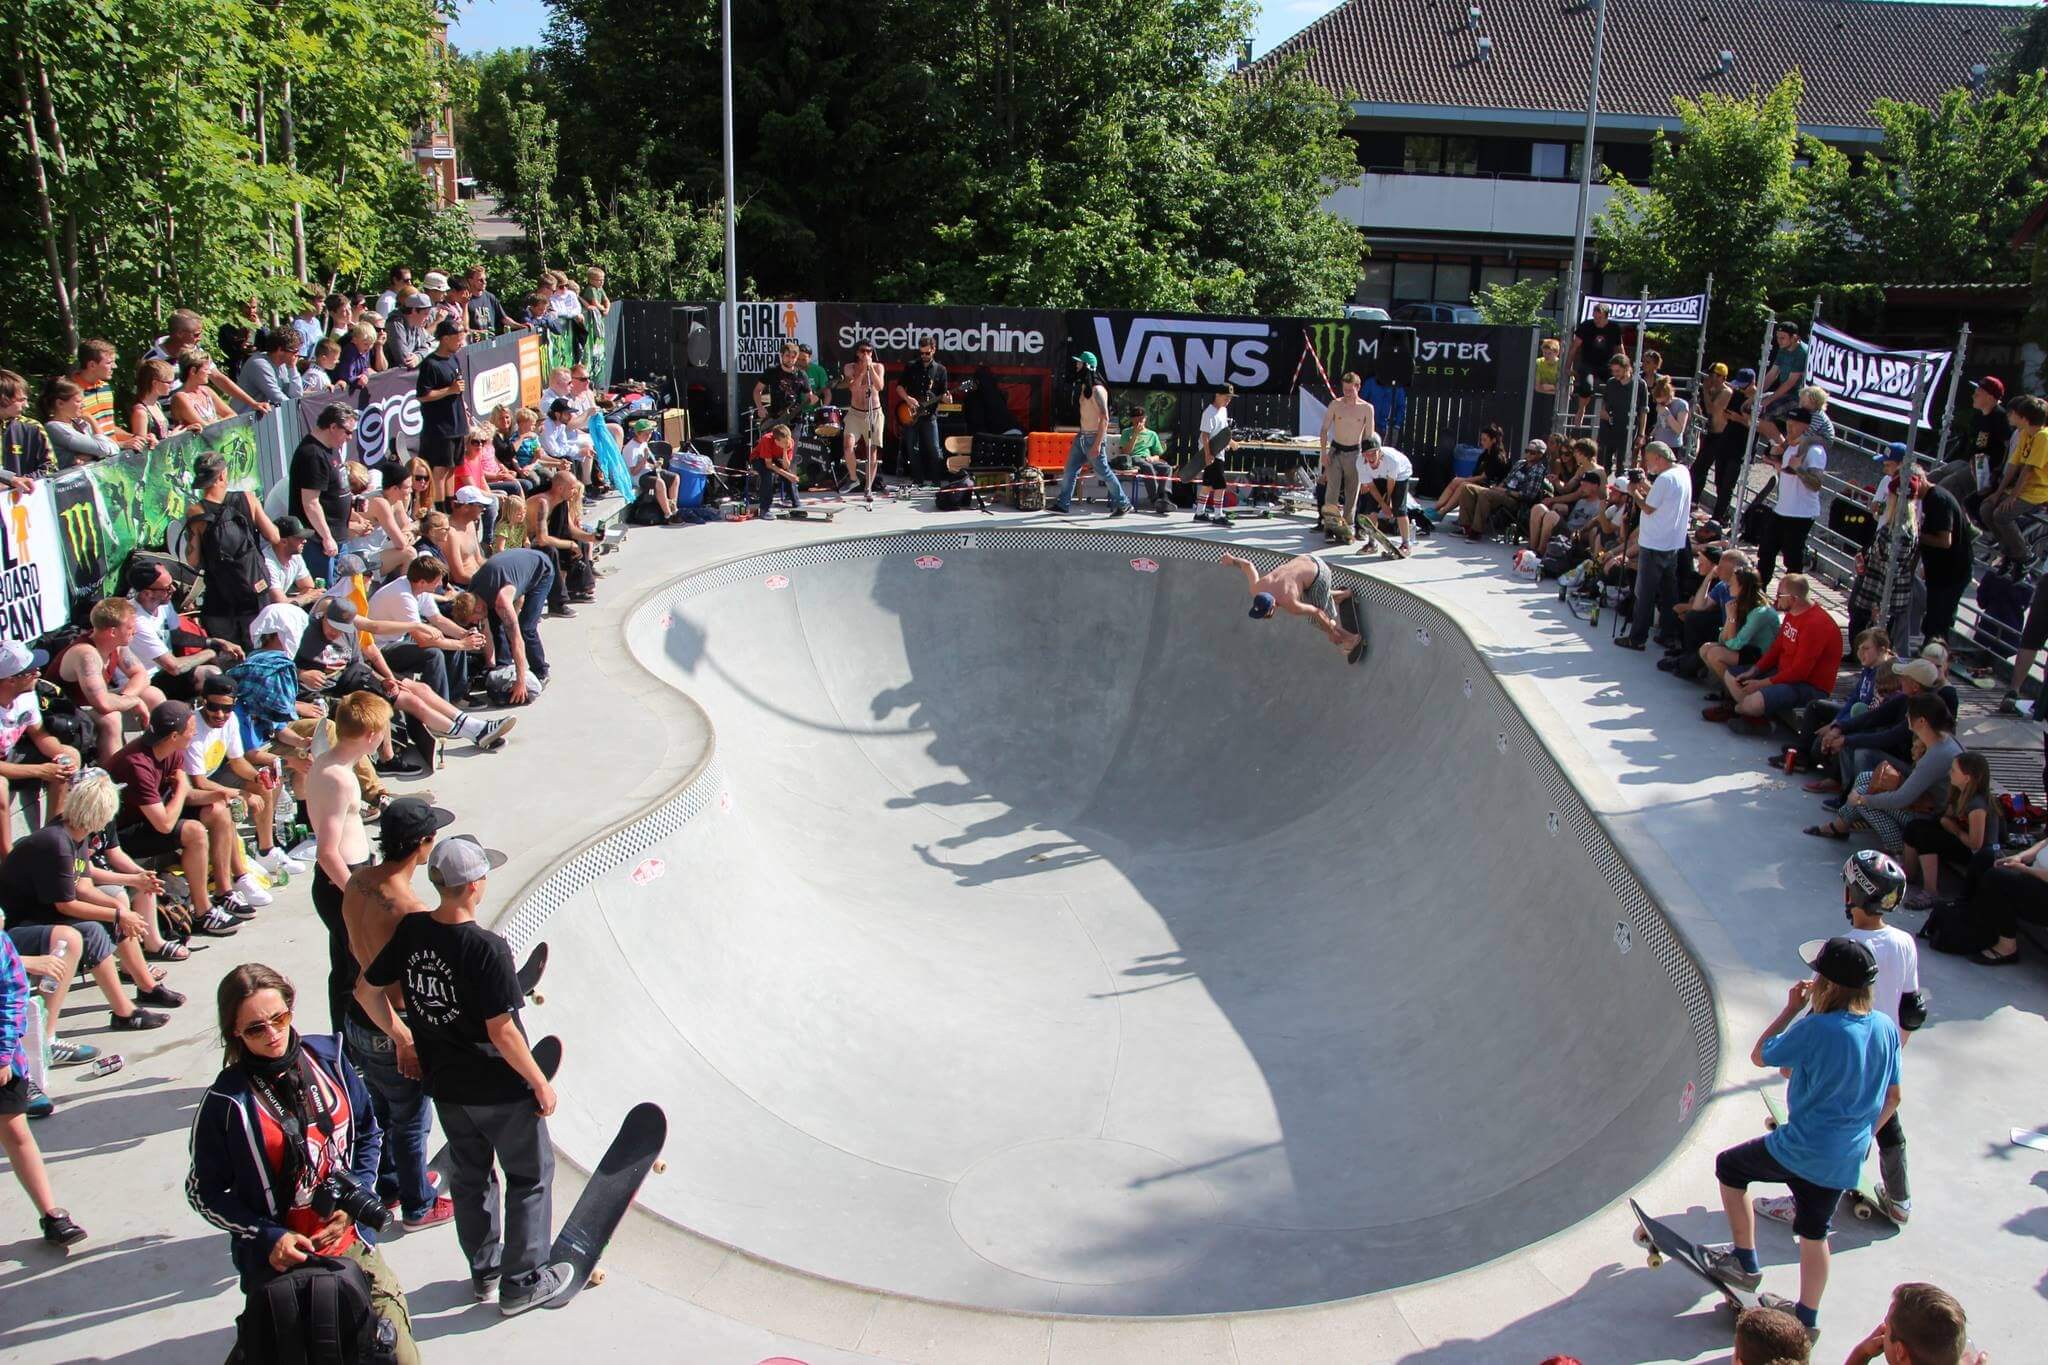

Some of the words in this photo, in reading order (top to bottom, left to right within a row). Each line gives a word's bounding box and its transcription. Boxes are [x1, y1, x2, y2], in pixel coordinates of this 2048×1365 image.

[737, 304, 787, 338] GIRL
[739, 353, 781, 372] COMPA
[1093, 316, 1271, 388] VANS
[1358, 337, 1492, 363] MSTER
[1805, 335, 1846, 384] BRICK
[264, 1088, 286, 1117] DIGITAL
[310, 1084, 325, 1113] Canon
